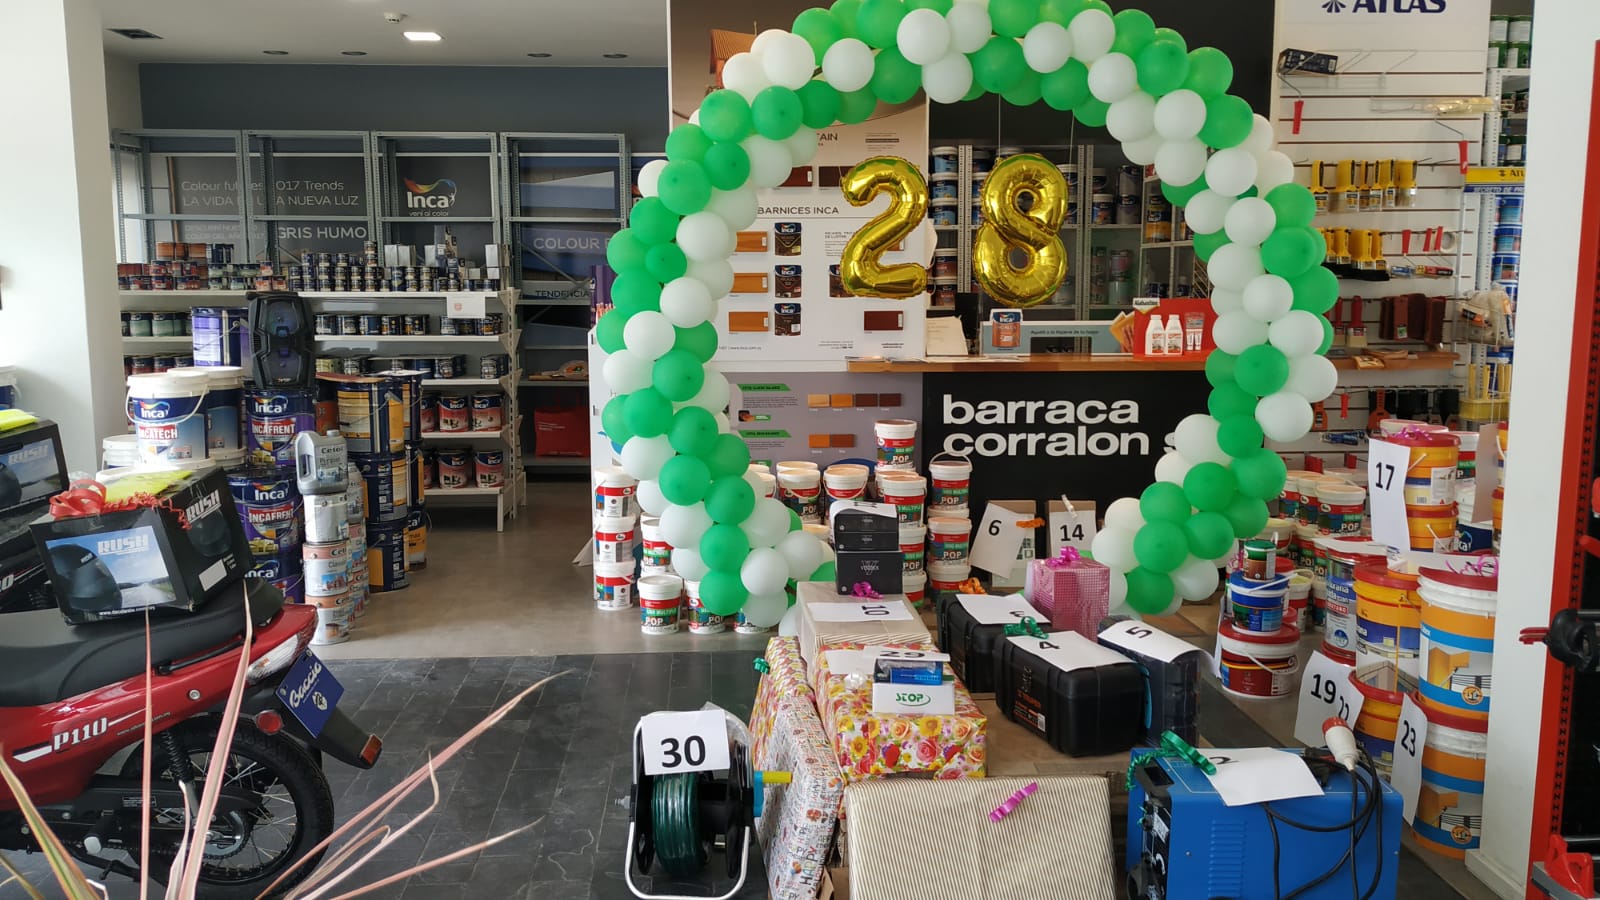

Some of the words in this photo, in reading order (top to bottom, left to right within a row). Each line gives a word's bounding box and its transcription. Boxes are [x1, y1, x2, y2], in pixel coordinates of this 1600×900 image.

[816, 132, 838, 141] AIN
[304, 181, 344, 190] Trends
[182, 196, 200, 206] LA
[202, 196, 234, 206] VIDA
[288, 195, 331, 206] NUEVA
[335, 195, 359, 206] LUZ
[407, 191, 449, 208] Inca
[757, 206, 811, 215] BARNICES
[813, 206, 839, 215] INCA
[277, 226, 313, 239] GRIS
[317, 226, 367, 239] HUMO
[533, 237, 601, 249] COLOUR
[141, 408, 166, 419] Inca
[255, 402, 283, 414] Inca
[943, 394, 1139, 425] barraca
[943, 425, 1150, 457] corralon
[1376, 462, 1395, 491] 17
[255, 489, 285, 501] Inca
[941, 496, 960, 504] POP
[185, 489, 222, 523] RUSH
[988, 519, 1002, 537] 6
[1060, 523, 1085, 541] 14
[97, 533, 149, 554] RUSH
[943, 552, 961, 560] POP
[903, 562, 920, 570] POP
[862, 604, 890, 616] 10
[645, 617, 664, 626] POP
[1125, 626, 1153, 640] 5
[1039, 641, 1061, 651] 4
[1311, 674, 1337, 704] 19
[895, 693, 925, 703] STOP
[53, 717, 109, 751] P110
[1401, 719, 1417, 758] 23
[660, 735, 706, 768] 30
